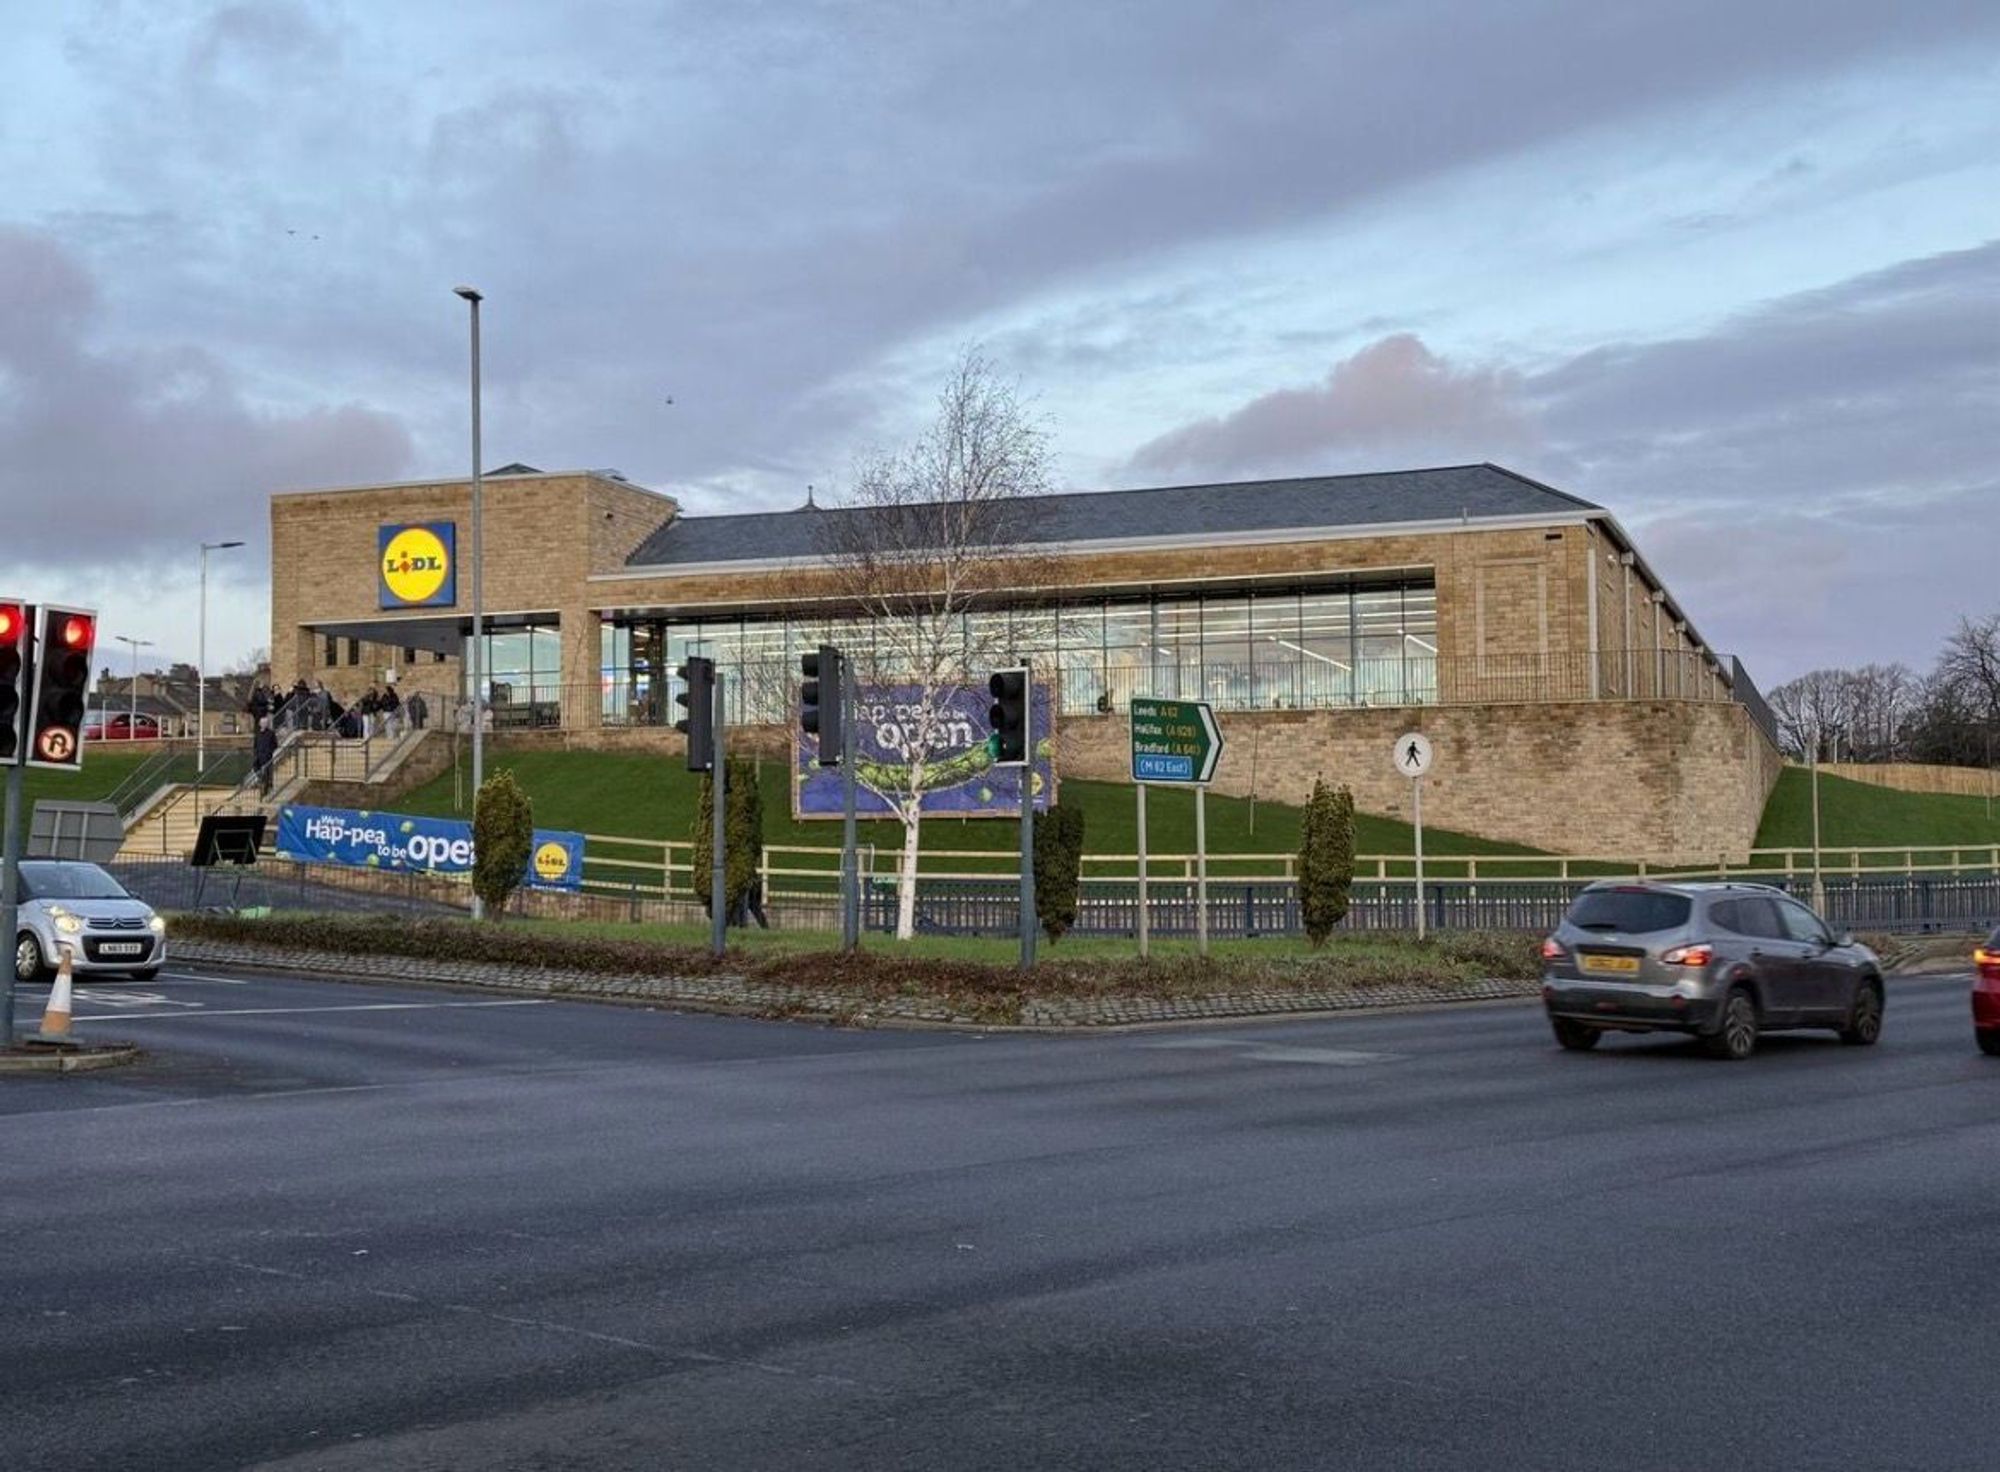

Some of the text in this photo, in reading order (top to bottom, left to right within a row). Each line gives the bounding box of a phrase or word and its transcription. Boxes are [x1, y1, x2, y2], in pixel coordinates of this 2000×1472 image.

[1135, 741, 1169, 754] Bradford
[306, 818, 386, 847] Hap-pea
[378, 845, 391, 856] to
[391, 843, 407, 859] be
